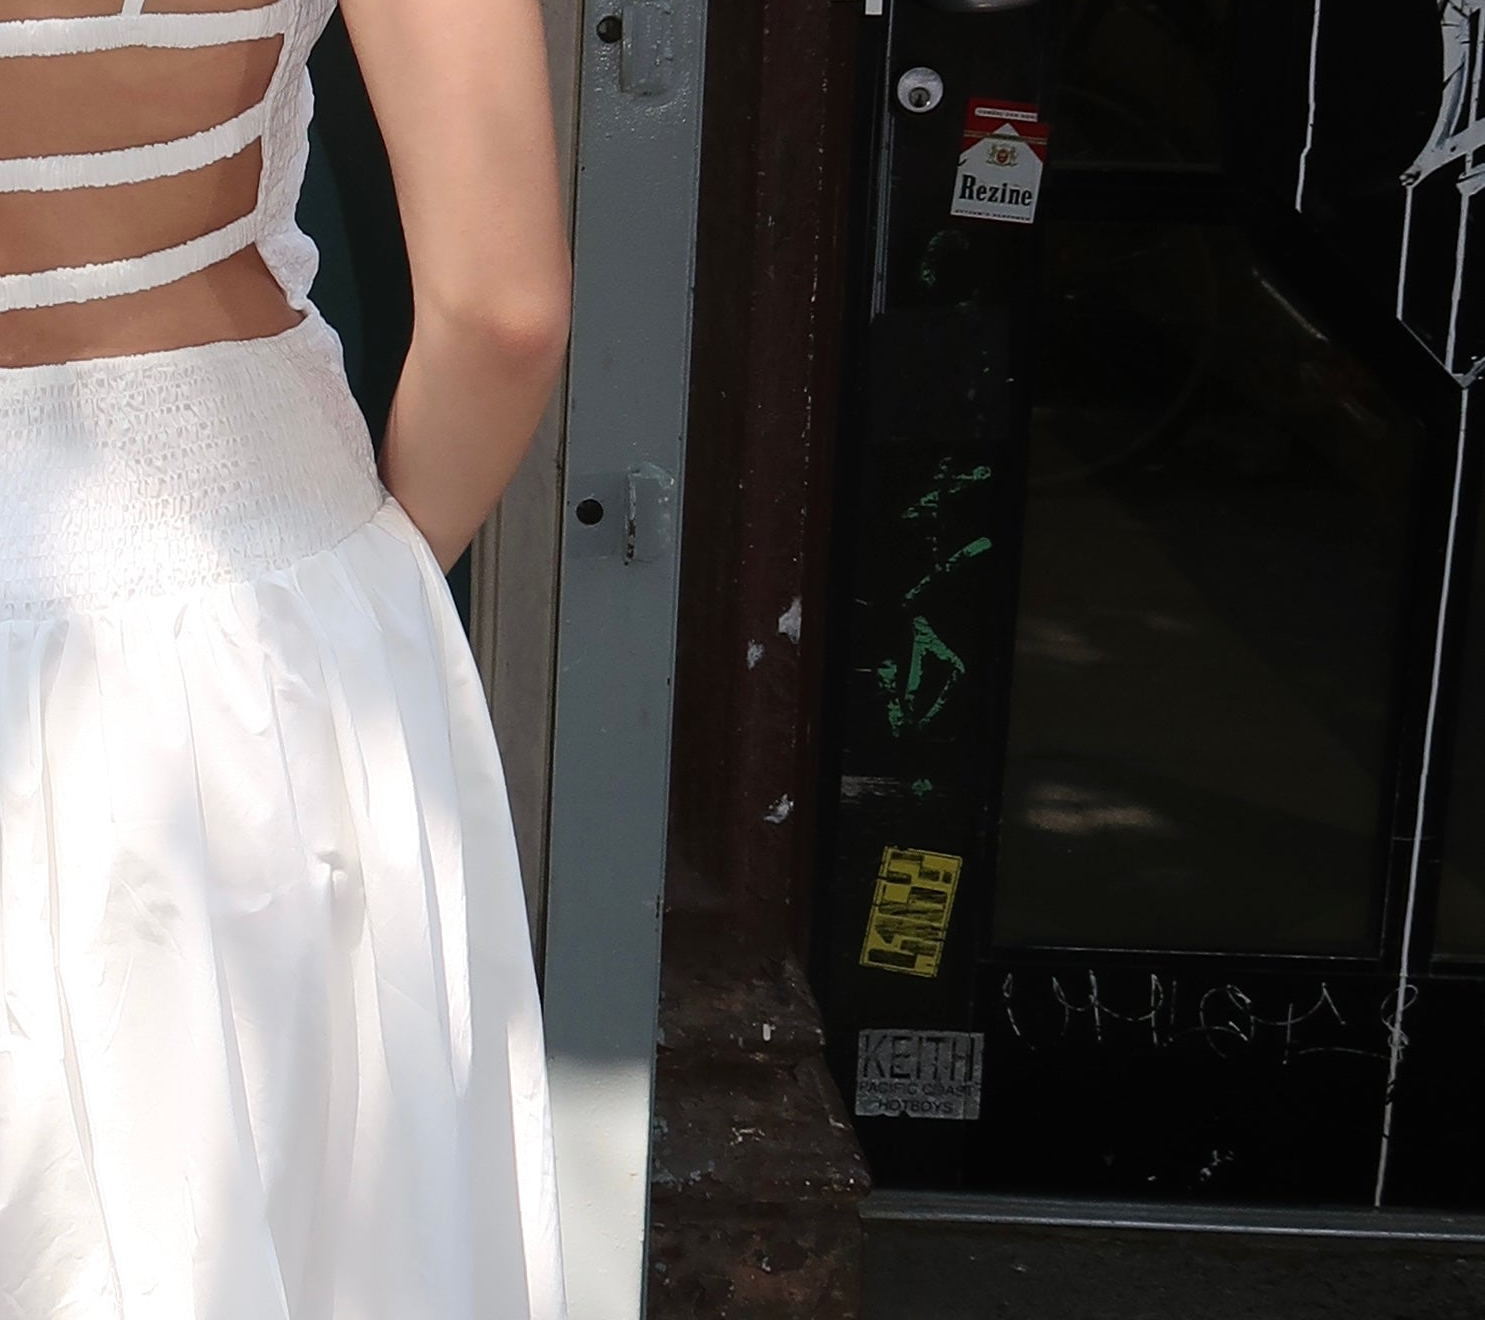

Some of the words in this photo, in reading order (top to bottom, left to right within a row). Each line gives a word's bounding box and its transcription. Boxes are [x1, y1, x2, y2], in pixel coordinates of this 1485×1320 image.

[959, 174, 1033, 206] Rezine
[863, 1035, 975, 1081] KEITH
[859, 1082, 917, 1095] PACIFIC
[878, 1100, 953, 1113] HOTBOYS
